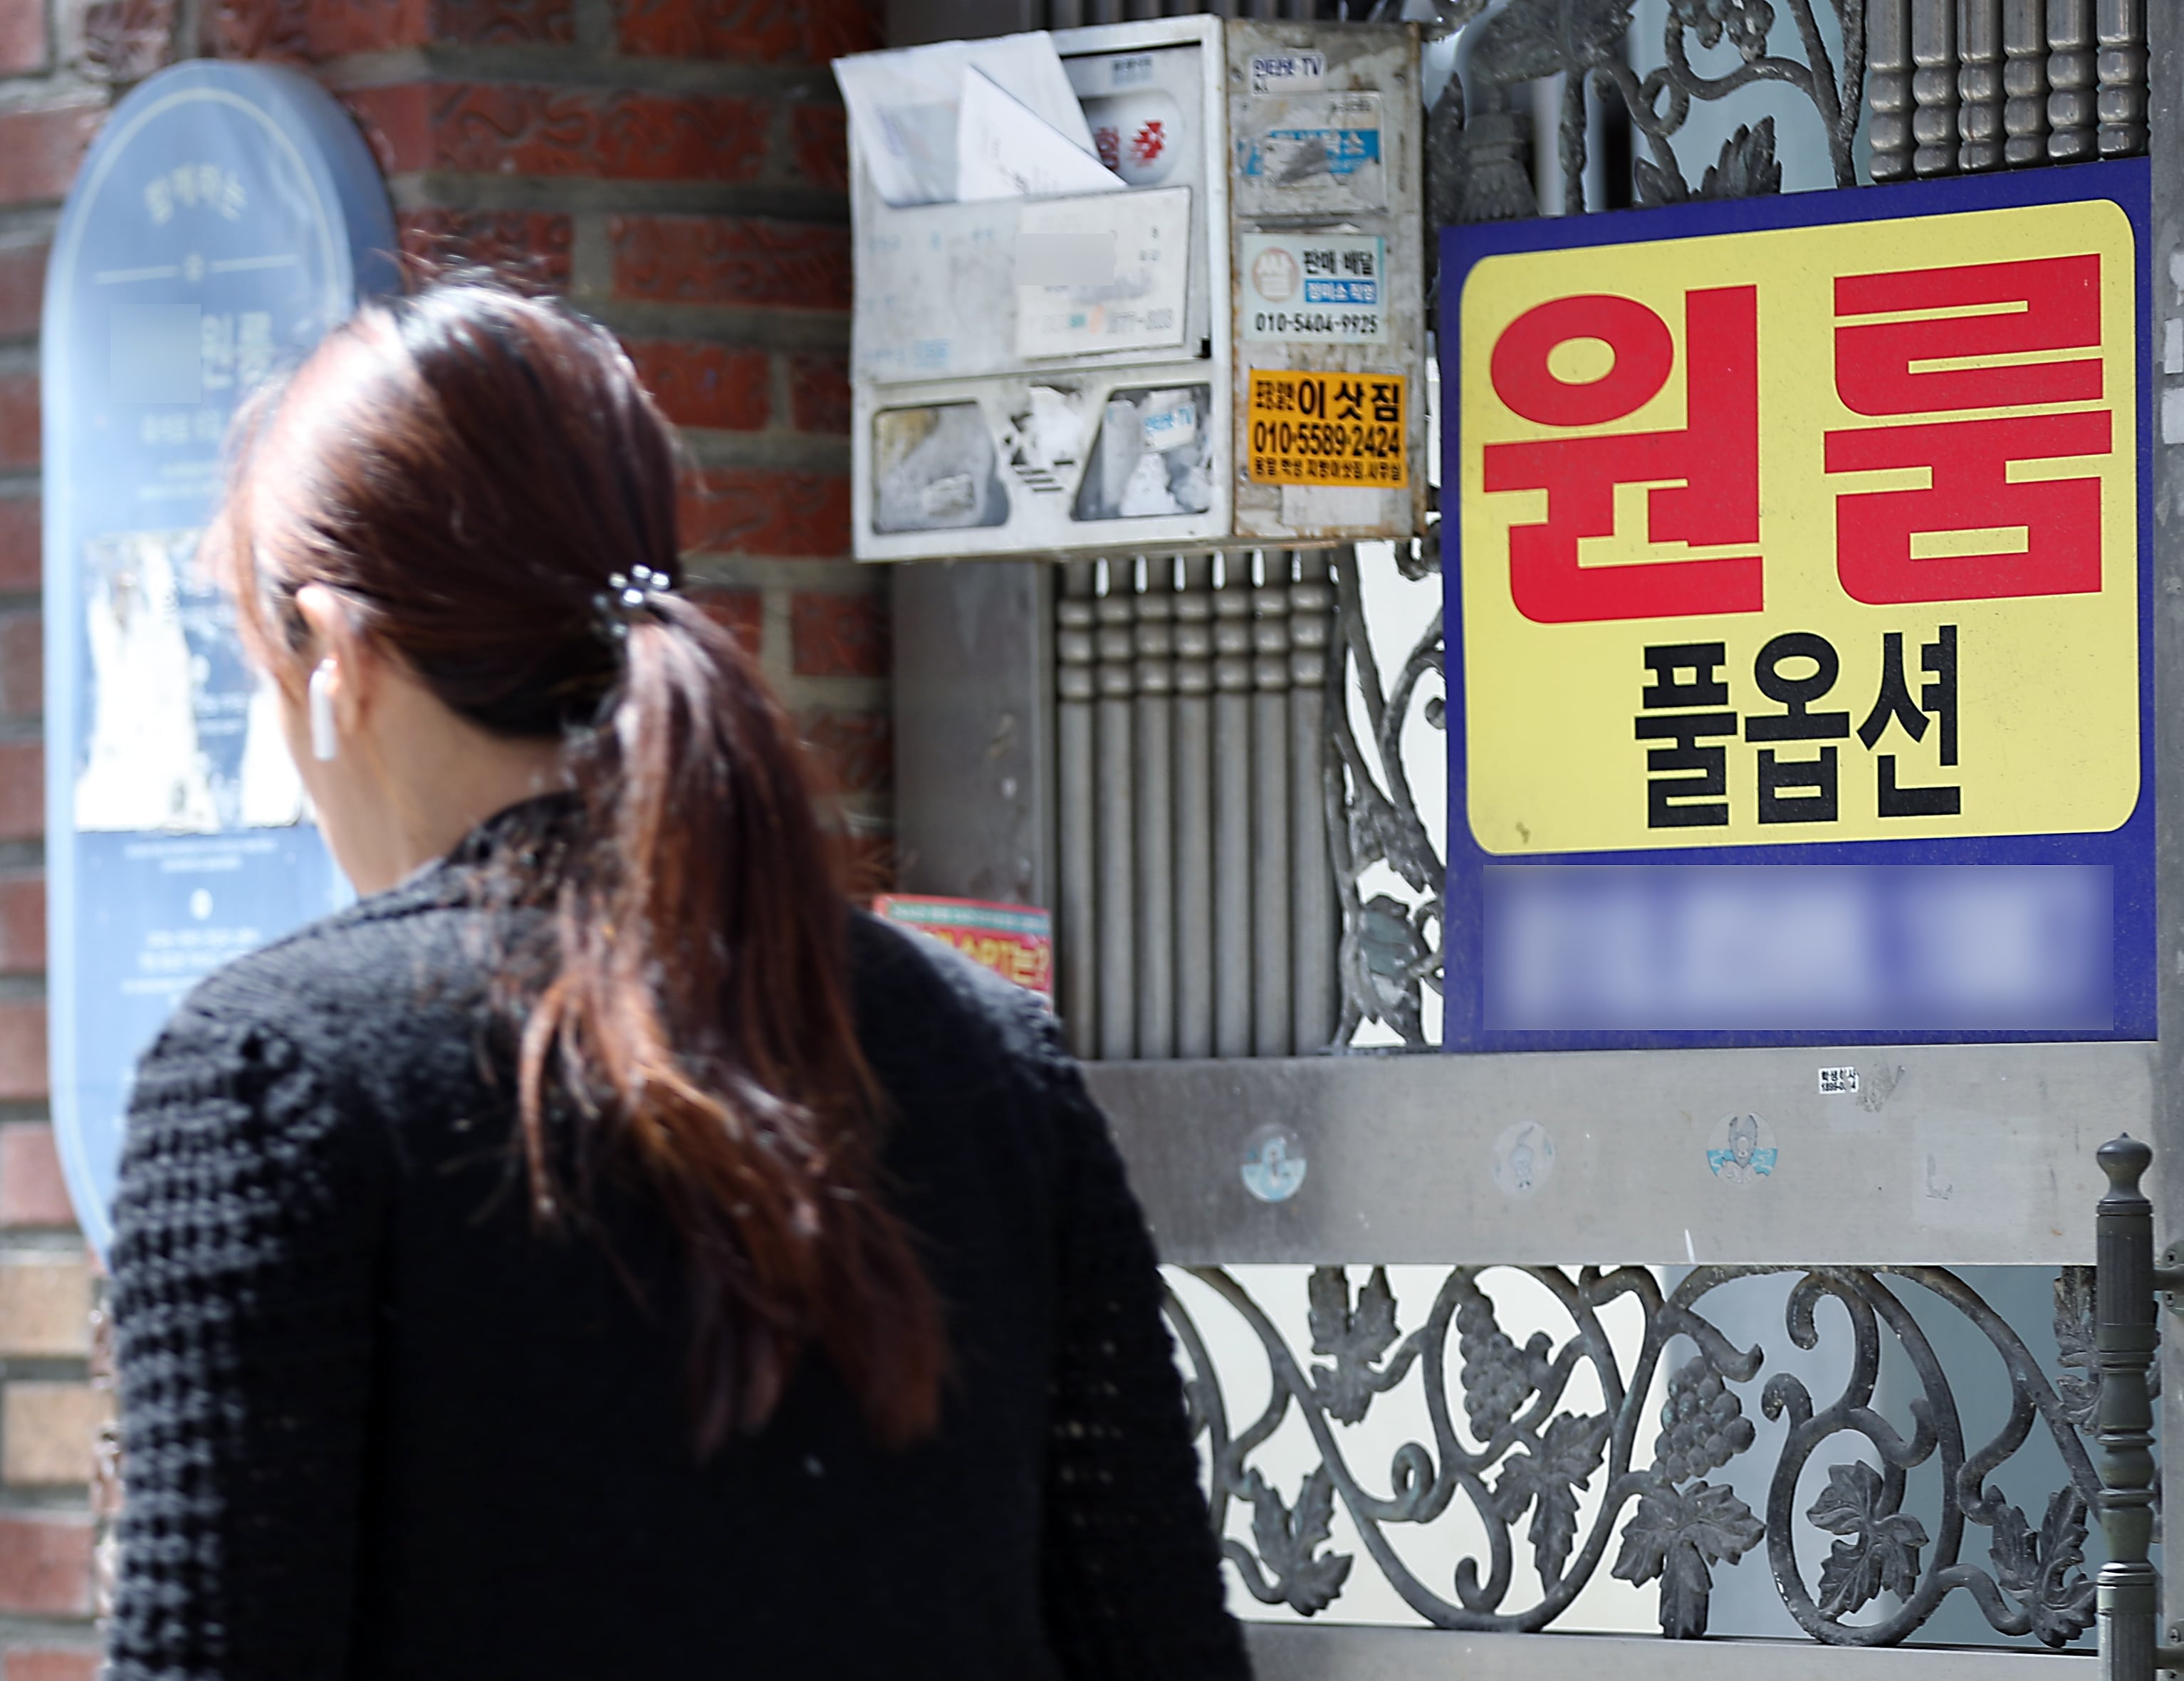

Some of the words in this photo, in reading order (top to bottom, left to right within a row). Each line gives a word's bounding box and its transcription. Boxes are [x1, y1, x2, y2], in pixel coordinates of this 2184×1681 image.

[1304, 249, 1336, 274] 판매
[1344, 250, 1373, 275] 배달
[1255, 312, 1378, 334] 010-5404-9925
[1298, 379, 1399, 421] 이삿짐
[1483, 253, 2114, 624] 원룸
[1634, 625, 1962, 829] 풀옵션
